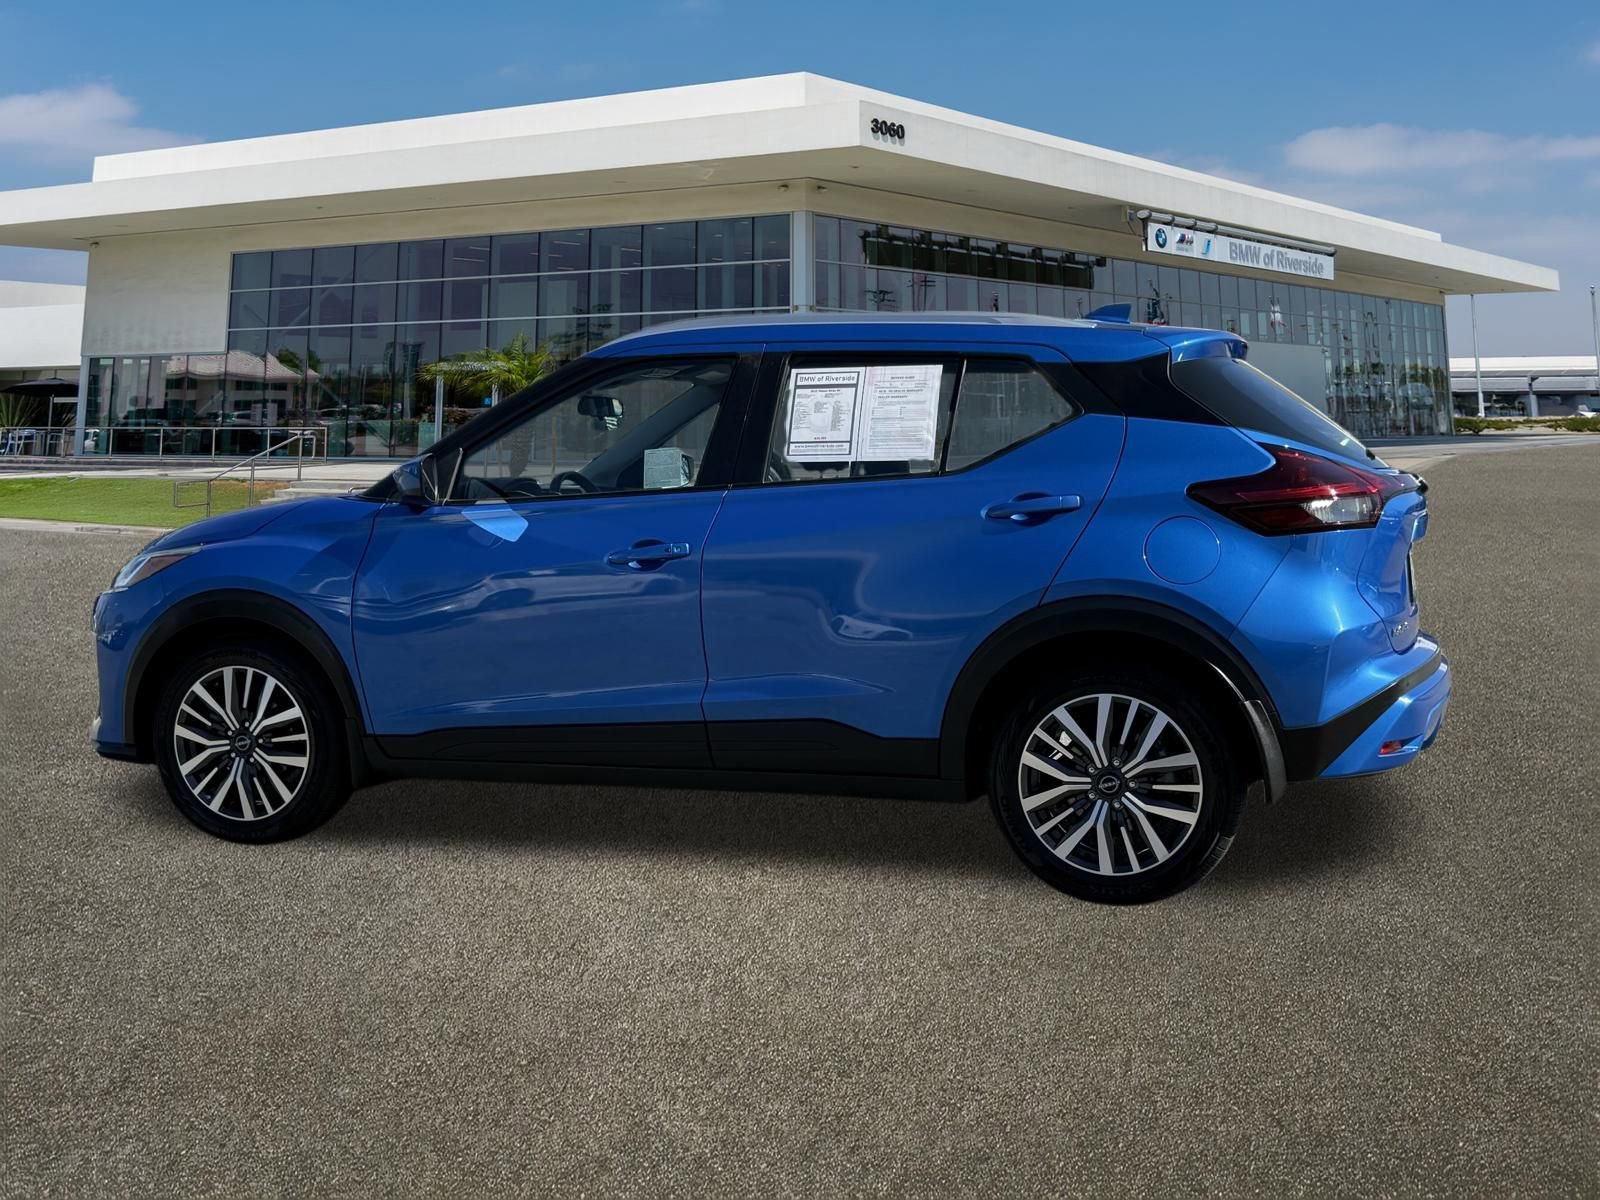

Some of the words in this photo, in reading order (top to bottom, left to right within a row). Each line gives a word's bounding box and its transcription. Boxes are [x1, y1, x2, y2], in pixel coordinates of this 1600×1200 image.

[870, 118, 905, 139] 3060
[1229, 241, 1261, 265] BMW
[1263, 249, 1275, 268] of
[1276, 250, 1324, 275] Riverside
[799, 375, 816, 383] BMW
